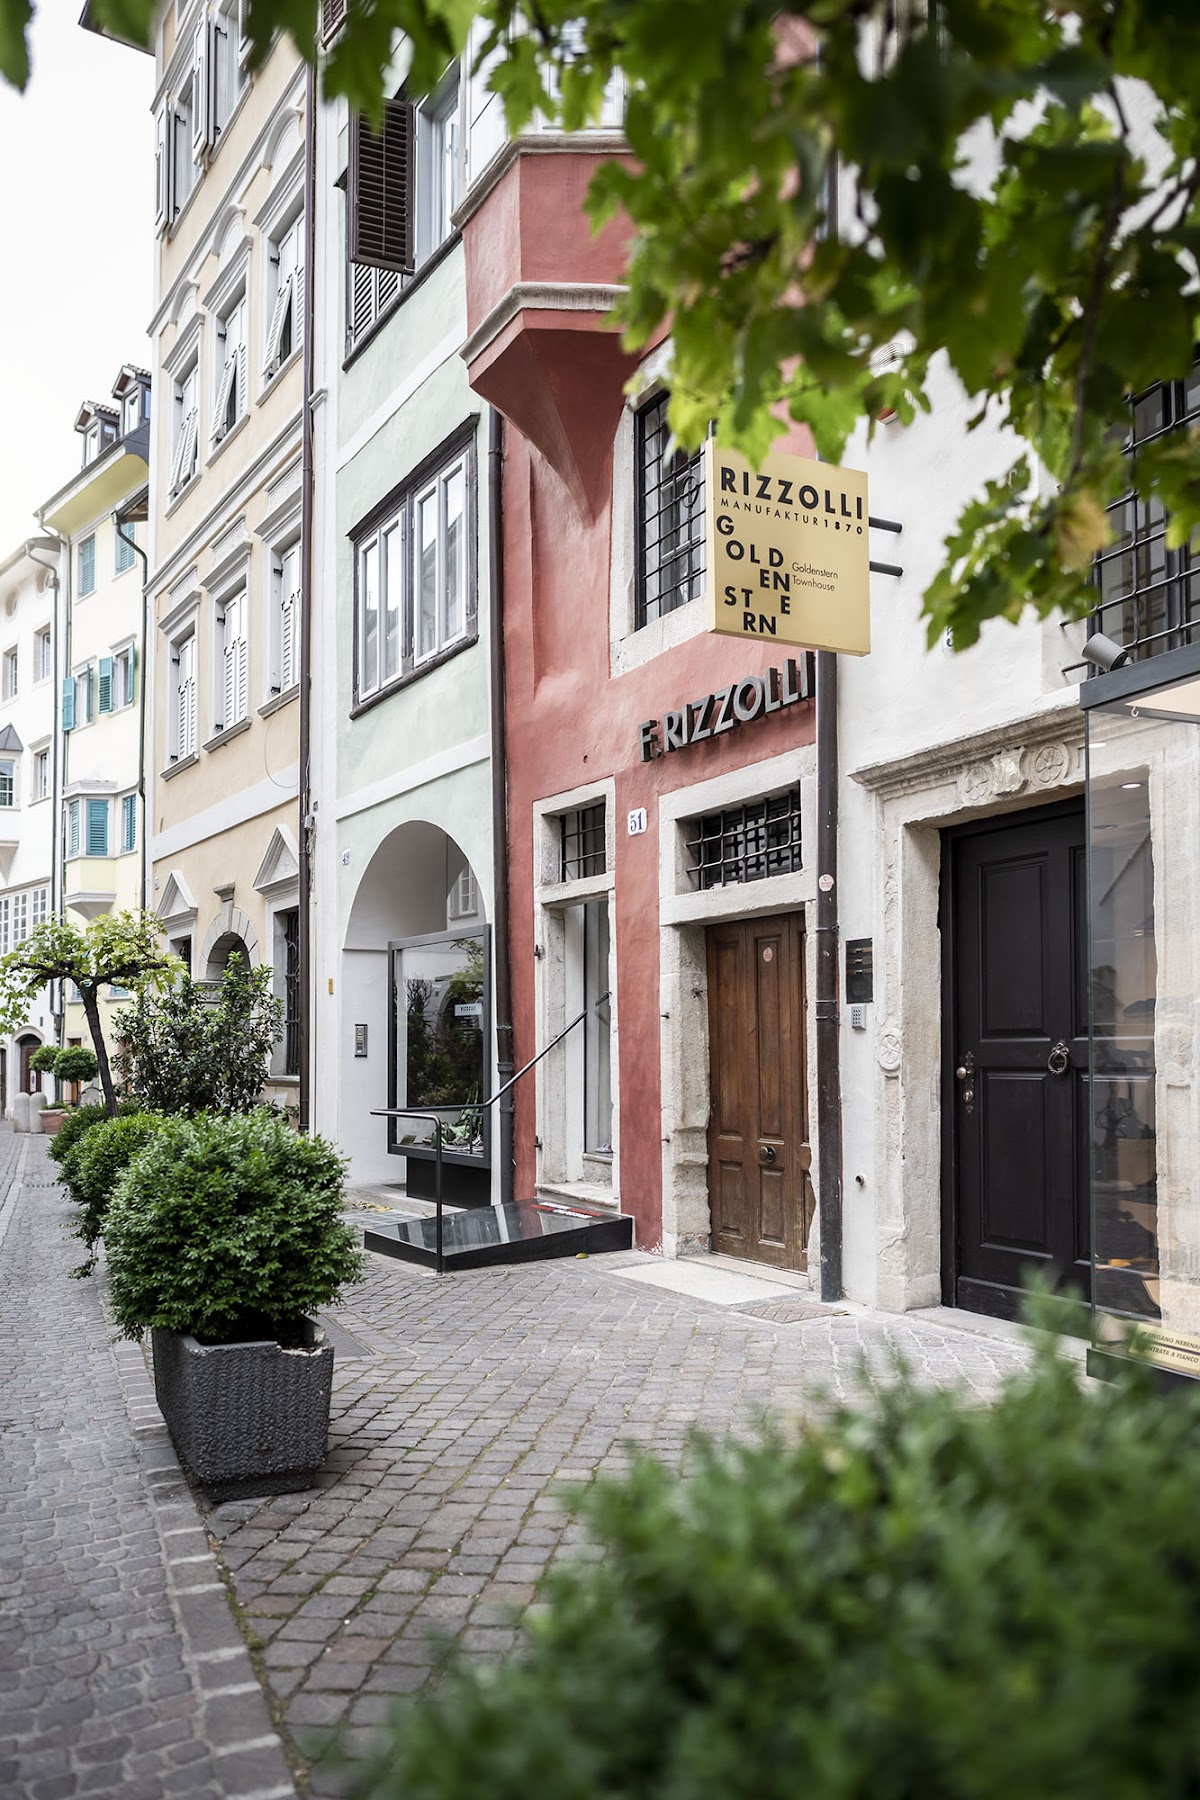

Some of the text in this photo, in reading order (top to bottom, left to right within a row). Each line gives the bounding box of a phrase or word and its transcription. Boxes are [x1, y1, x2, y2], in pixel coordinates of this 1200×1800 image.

[720, 466, 863, 520] RIZZOLLI
[720, 497, 863, 535] MANUFAKTUR 1870
[792, 562, 839, 580] Goldenstern
[792, 574, 836, 592] Townhouse
[630, 812, 643, 832] 51
[1176, 1353, 1199, 1363] FIANCO
